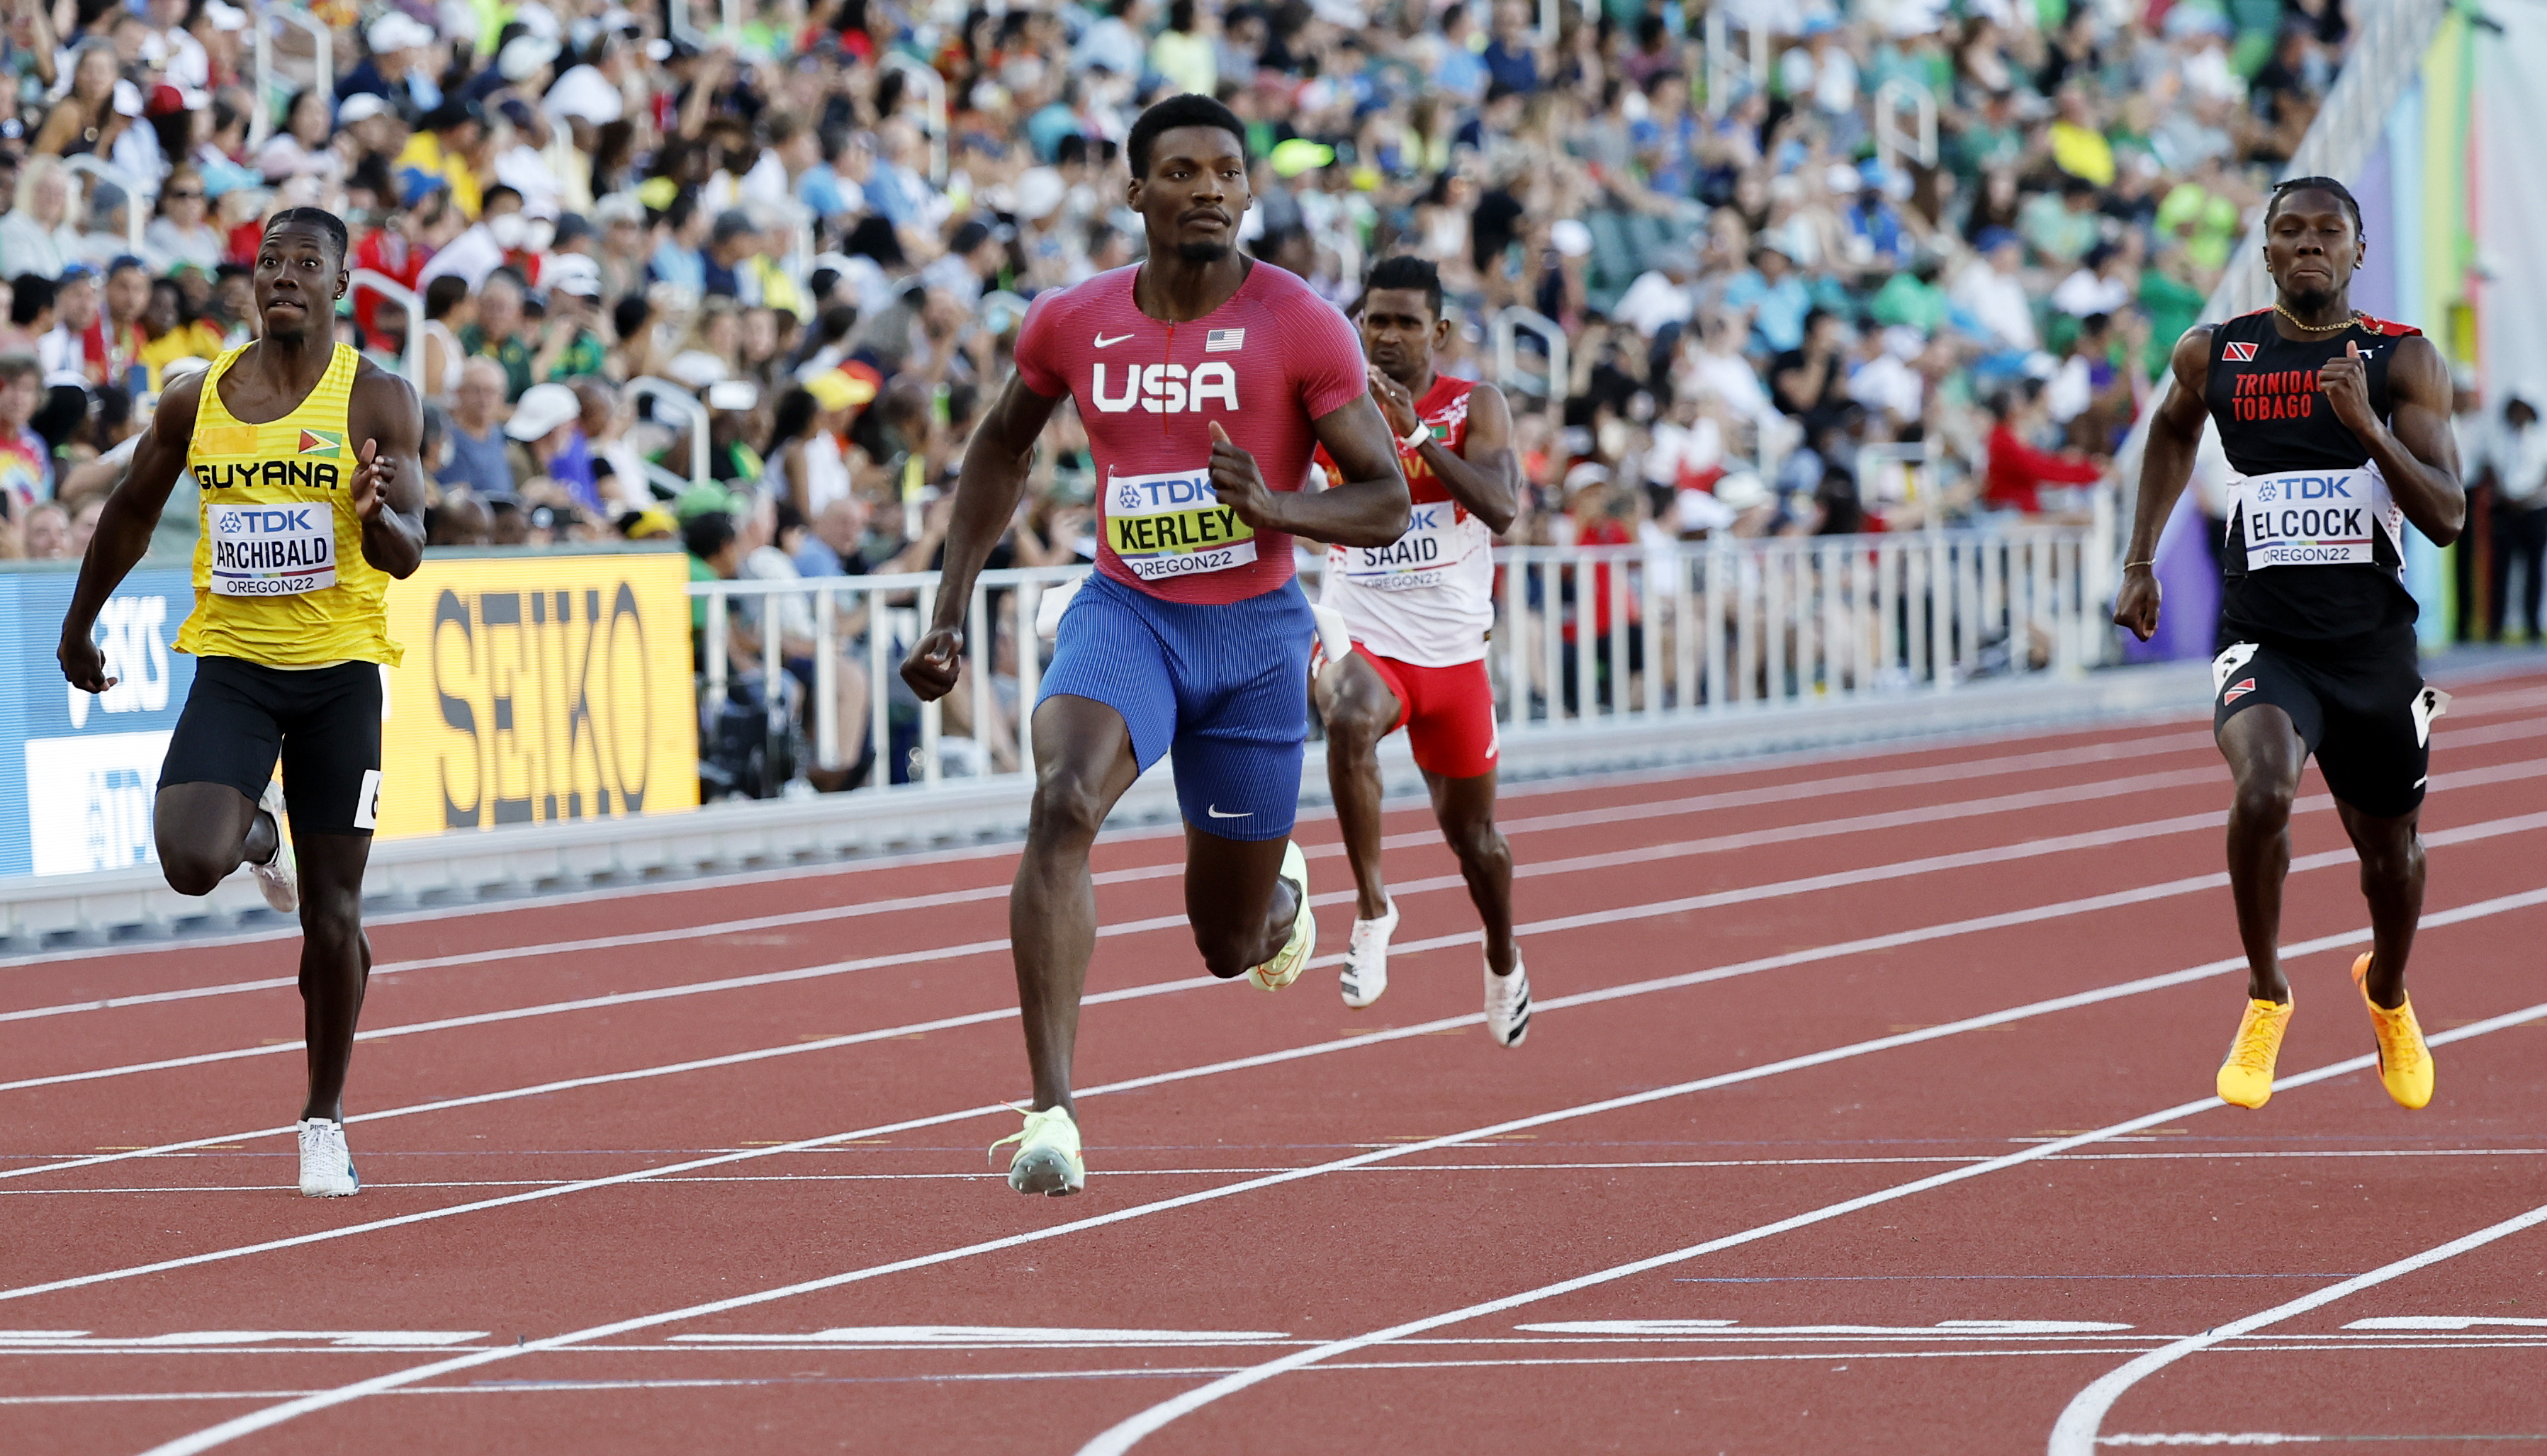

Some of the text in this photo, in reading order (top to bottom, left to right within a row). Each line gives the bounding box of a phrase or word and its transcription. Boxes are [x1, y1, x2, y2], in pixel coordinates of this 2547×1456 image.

[1092, 361, 1239, 414] USA
[2232, 394, 2312, 422] TOBAGO
[194, 461, 339, 490] GUYANA
[2277, 476, 2351, 500] TDK
[241, 509, 313, 533] TDK
[1118, 508, 1236, 550] KERLEY
[2252, 508, 2362, 542] ELCOCK
[216, 536, 327, 570] ARCHIBALD
[1131, 551, 1234, 577] OREGON22
[1364, 537, 1437, 567] SAAID
[2263, 548, 2350, 564] OREGON22
[227, 577, 315, 593] OREGON22
[434, 582, 650, 828] SEIKO
